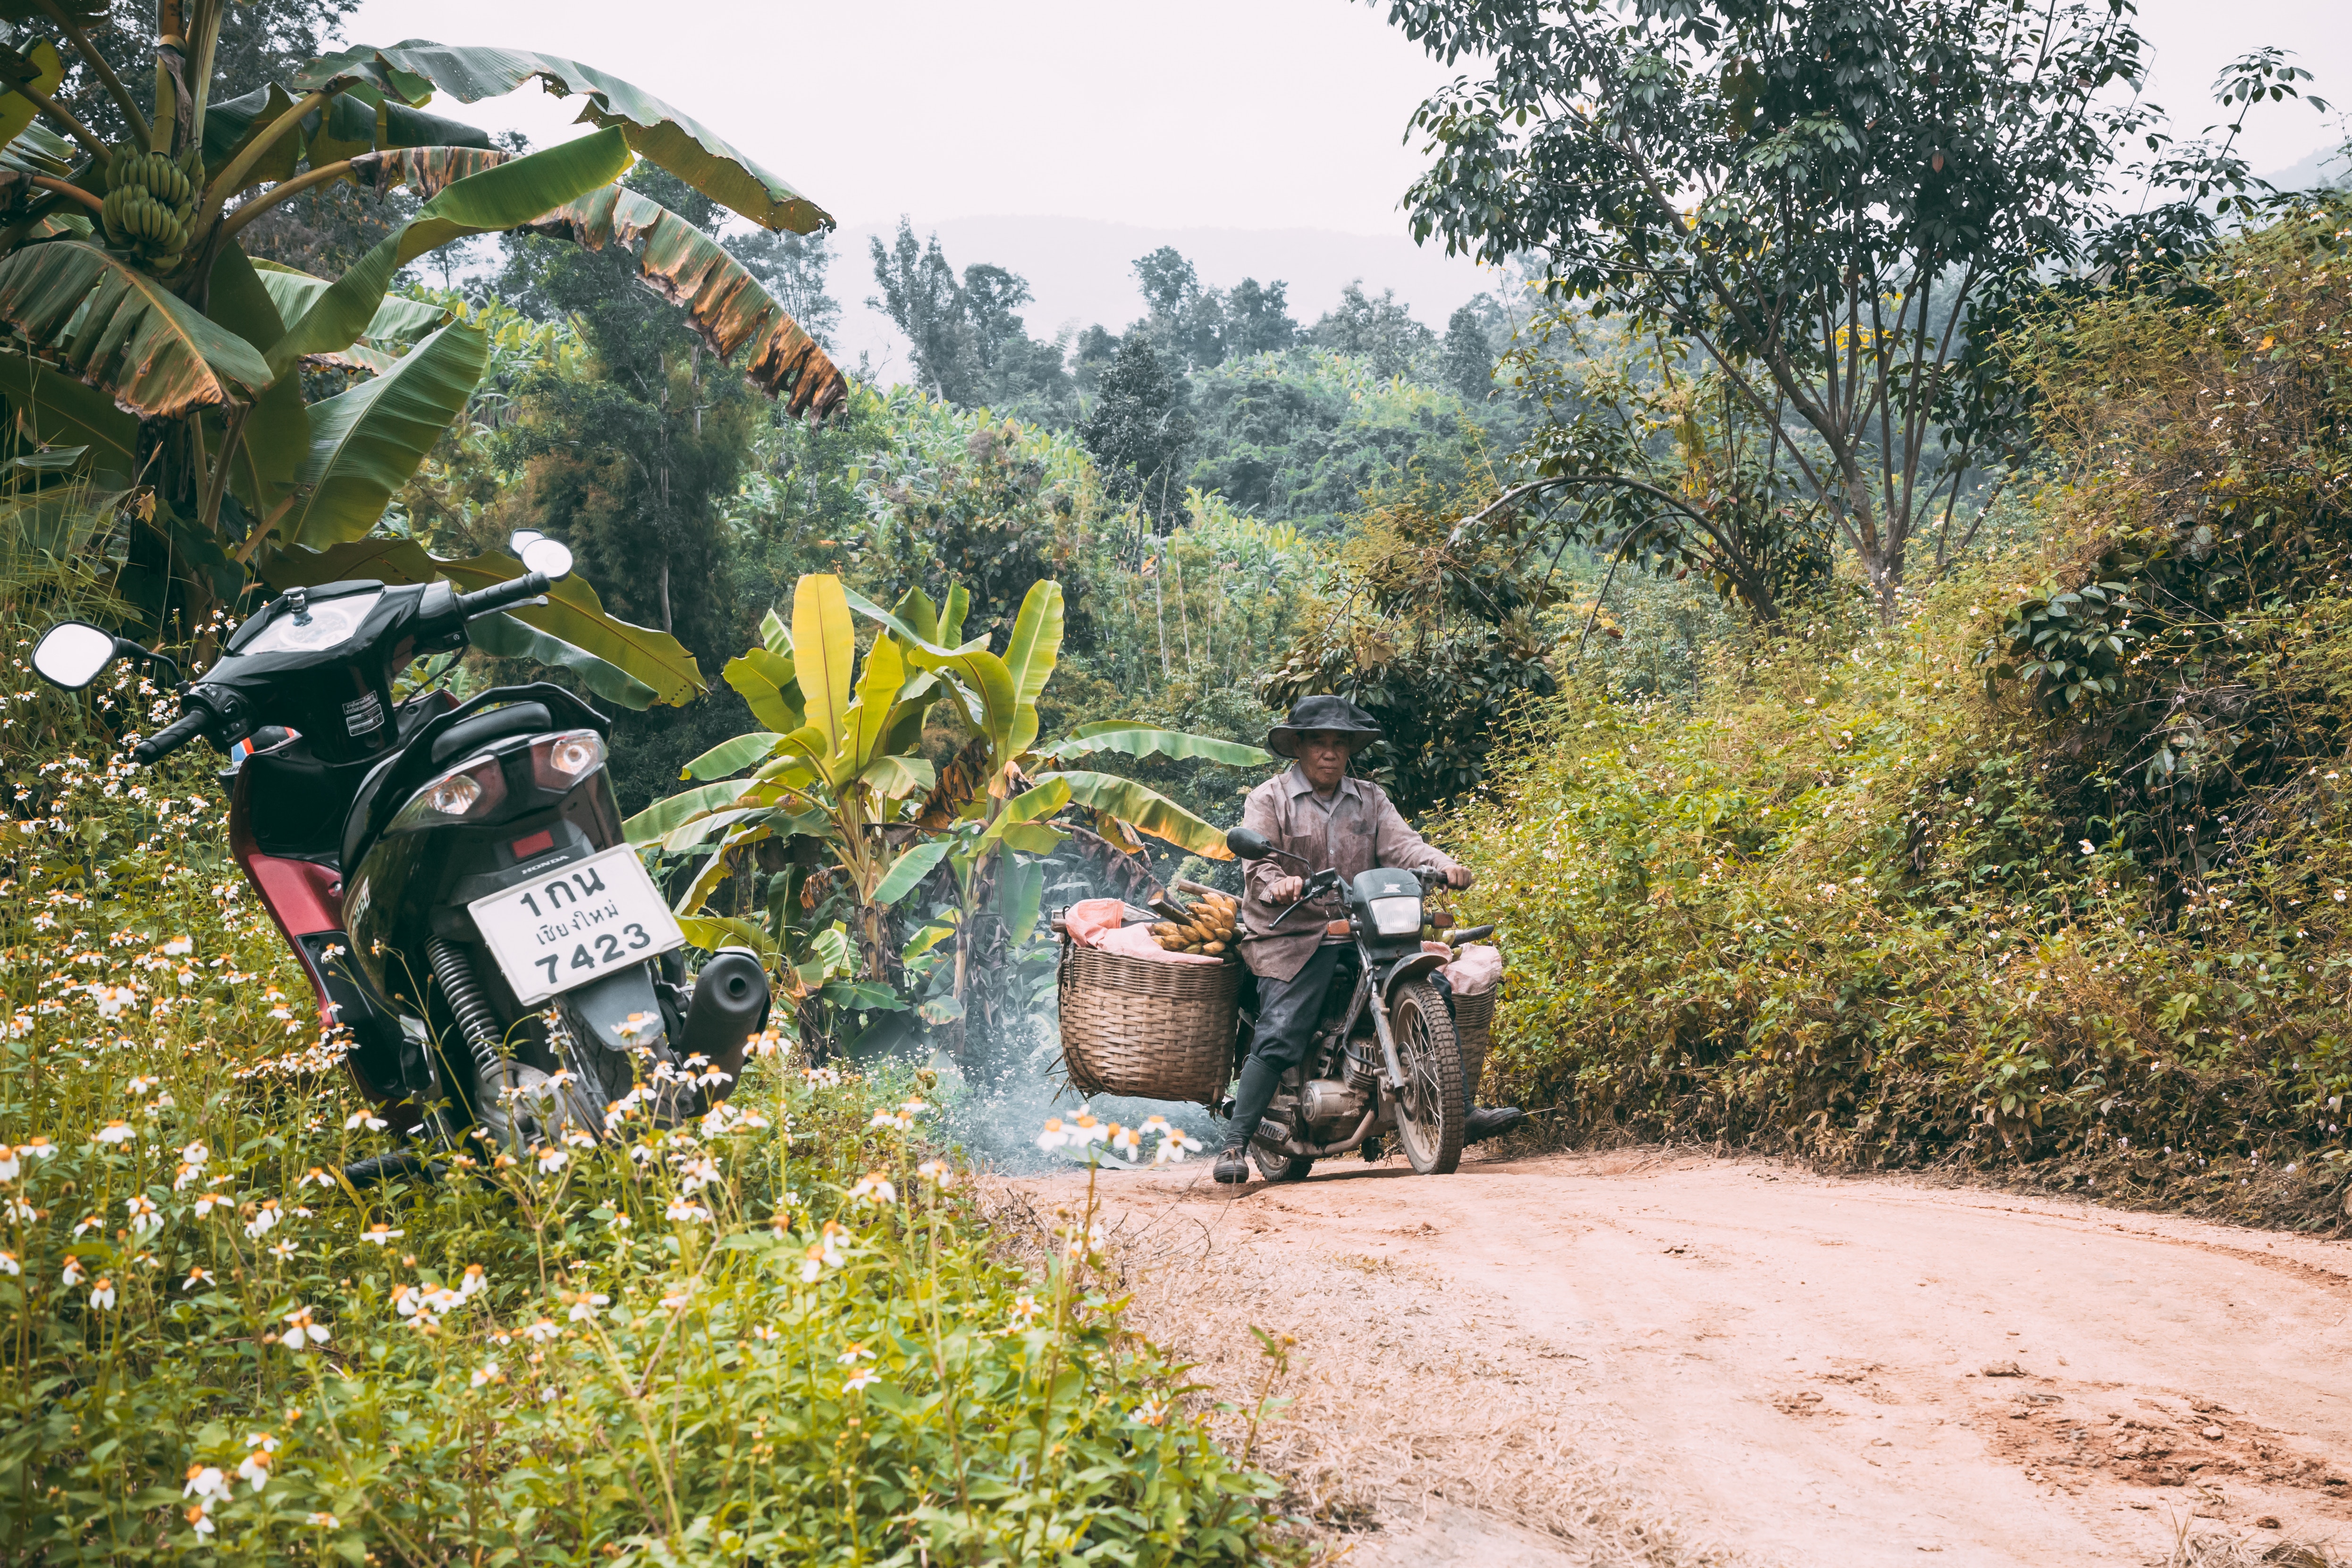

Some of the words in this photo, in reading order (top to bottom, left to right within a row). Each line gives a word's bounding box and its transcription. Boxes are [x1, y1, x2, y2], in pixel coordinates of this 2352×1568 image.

[522, 856, 570, 874] HONDA
[537, 900, 618, 945] เชียงใหม่
[535, 923, 650, 984] 7423
